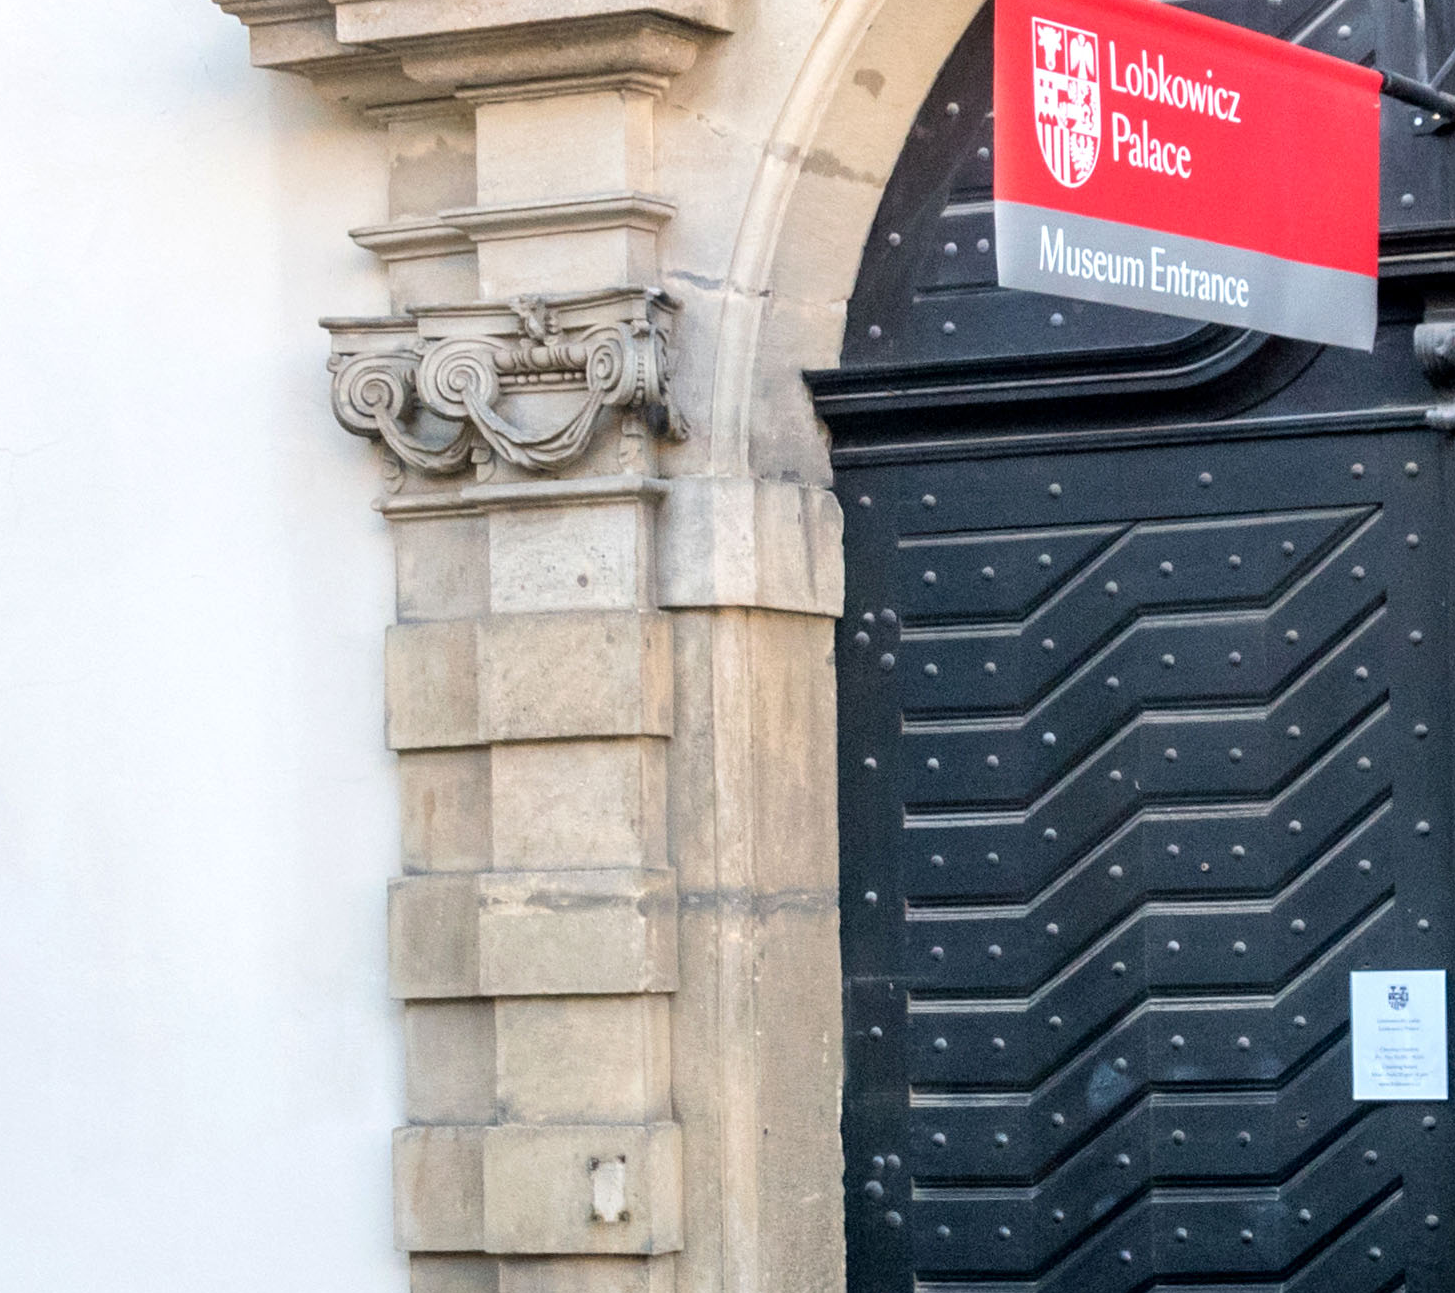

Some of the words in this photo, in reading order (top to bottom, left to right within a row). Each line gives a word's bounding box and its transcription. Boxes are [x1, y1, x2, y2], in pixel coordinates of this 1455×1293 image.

[1108, 40, 1242, 124] Lobkowicz
[1111, 112, 1193, 179] Palace
[1038, 224, 1145, 289] Museum
[1150, 246, 1250, 308] Entrance
